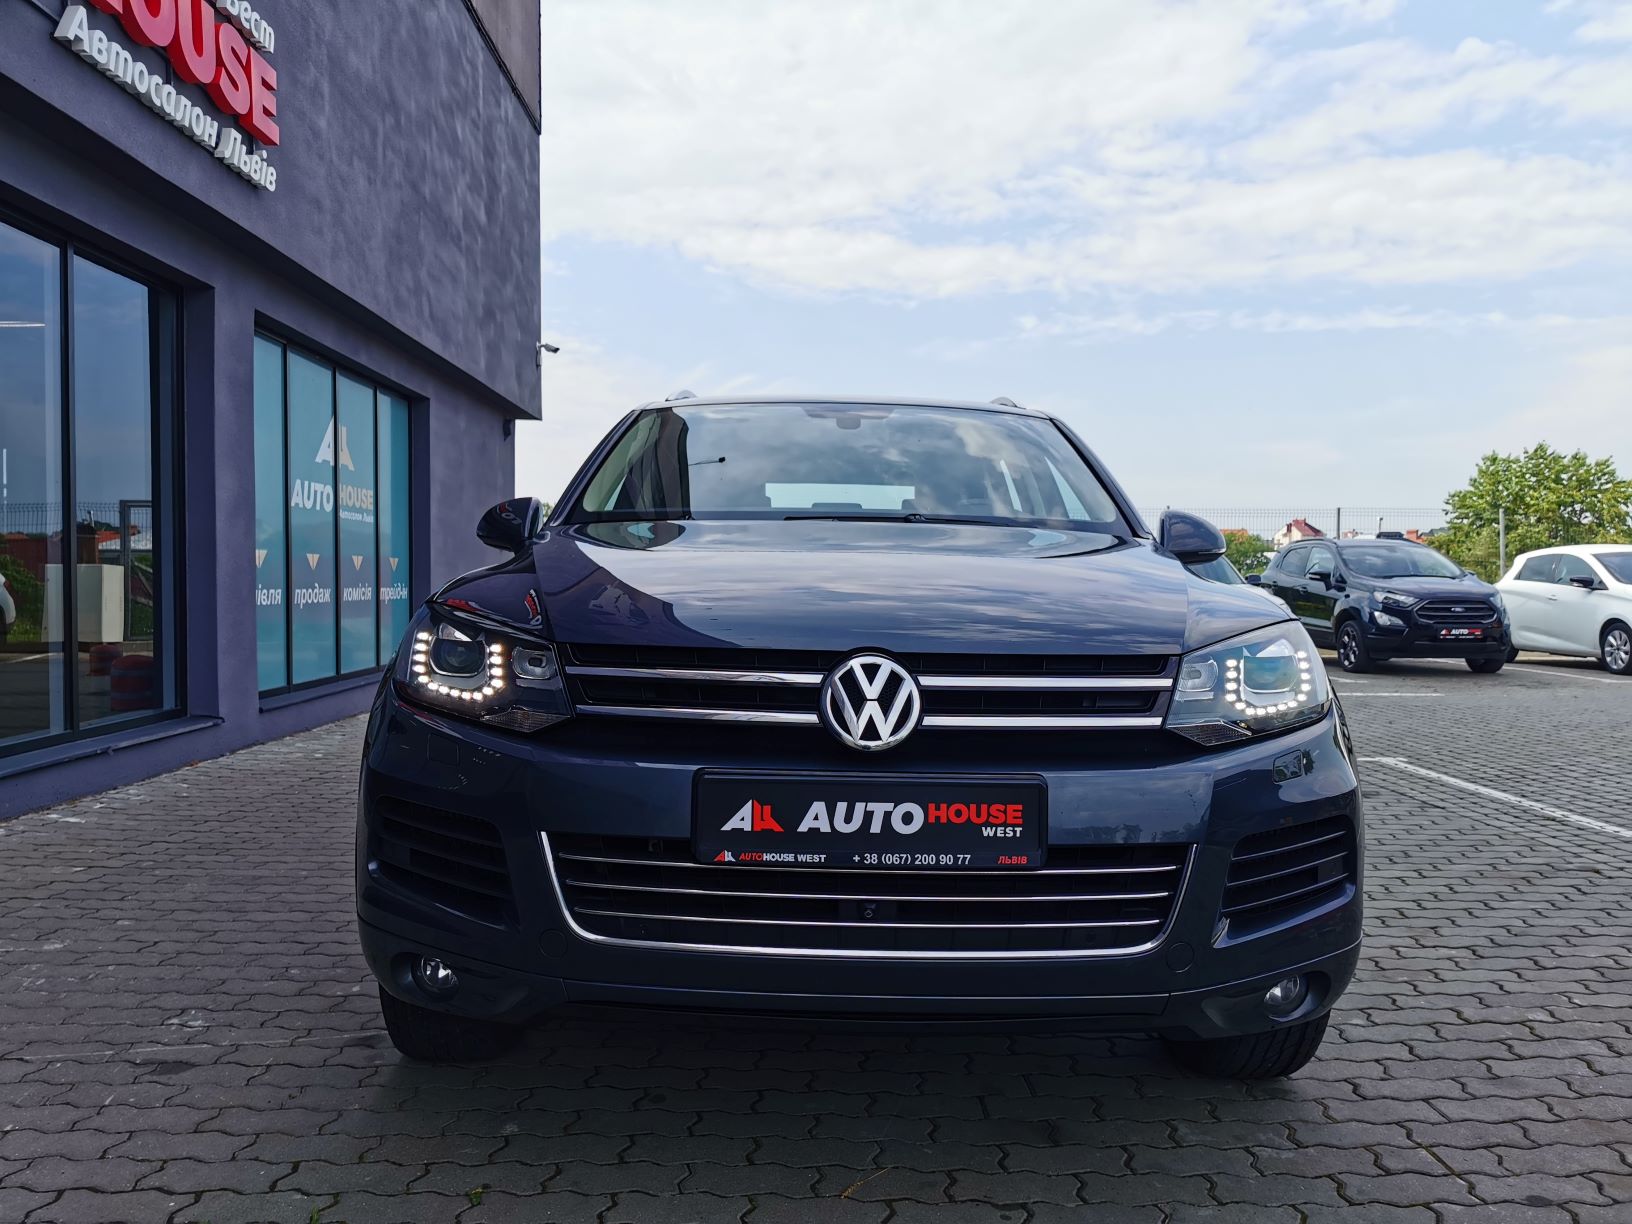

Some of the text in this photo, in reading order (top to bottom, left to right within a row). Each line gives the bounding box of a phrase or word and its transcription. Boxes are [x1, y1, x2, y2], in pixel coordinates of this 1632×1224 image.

[54, 5, 277, 192] Автосалон Львів
[291, 479, 374, 512] AUTO HOUSE
[255, 583, 282, 605] івля
[294, 582, 331, 609] продаж
[343, 583, 372, 601] комісія
[982, 826, 1023, 837] WEST
[797, 853, 826, 863] WEST
[863, 853, 878, 864] 38
[881, 853, 912, 865] (067)
[914, 854, 936, 865] 200
[939, 854, 954, 865] 90
[956, 854, 972, 865] 77
